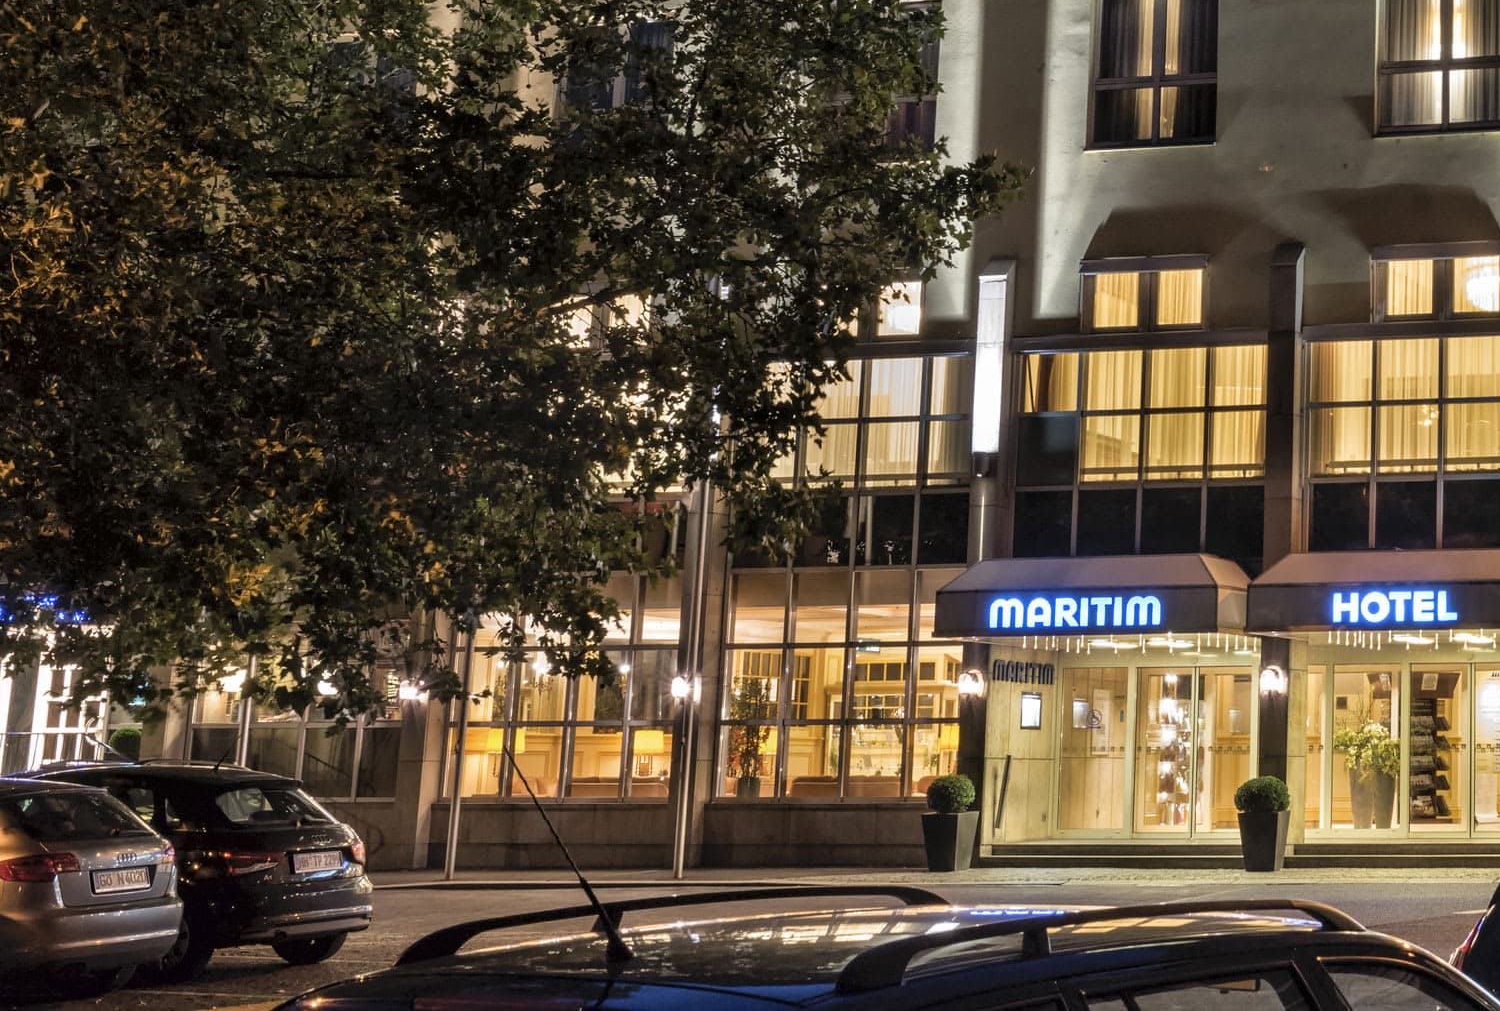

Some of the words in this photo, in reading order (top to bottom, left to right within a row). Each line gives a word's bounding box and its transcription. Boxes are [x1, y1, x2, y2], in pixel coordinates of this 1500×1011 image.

[989, 595, 1162, 629] MARITIM
[1332, 590, 1458, 623] HOTEL
[992, 659, 1055, 685] MARITIM
